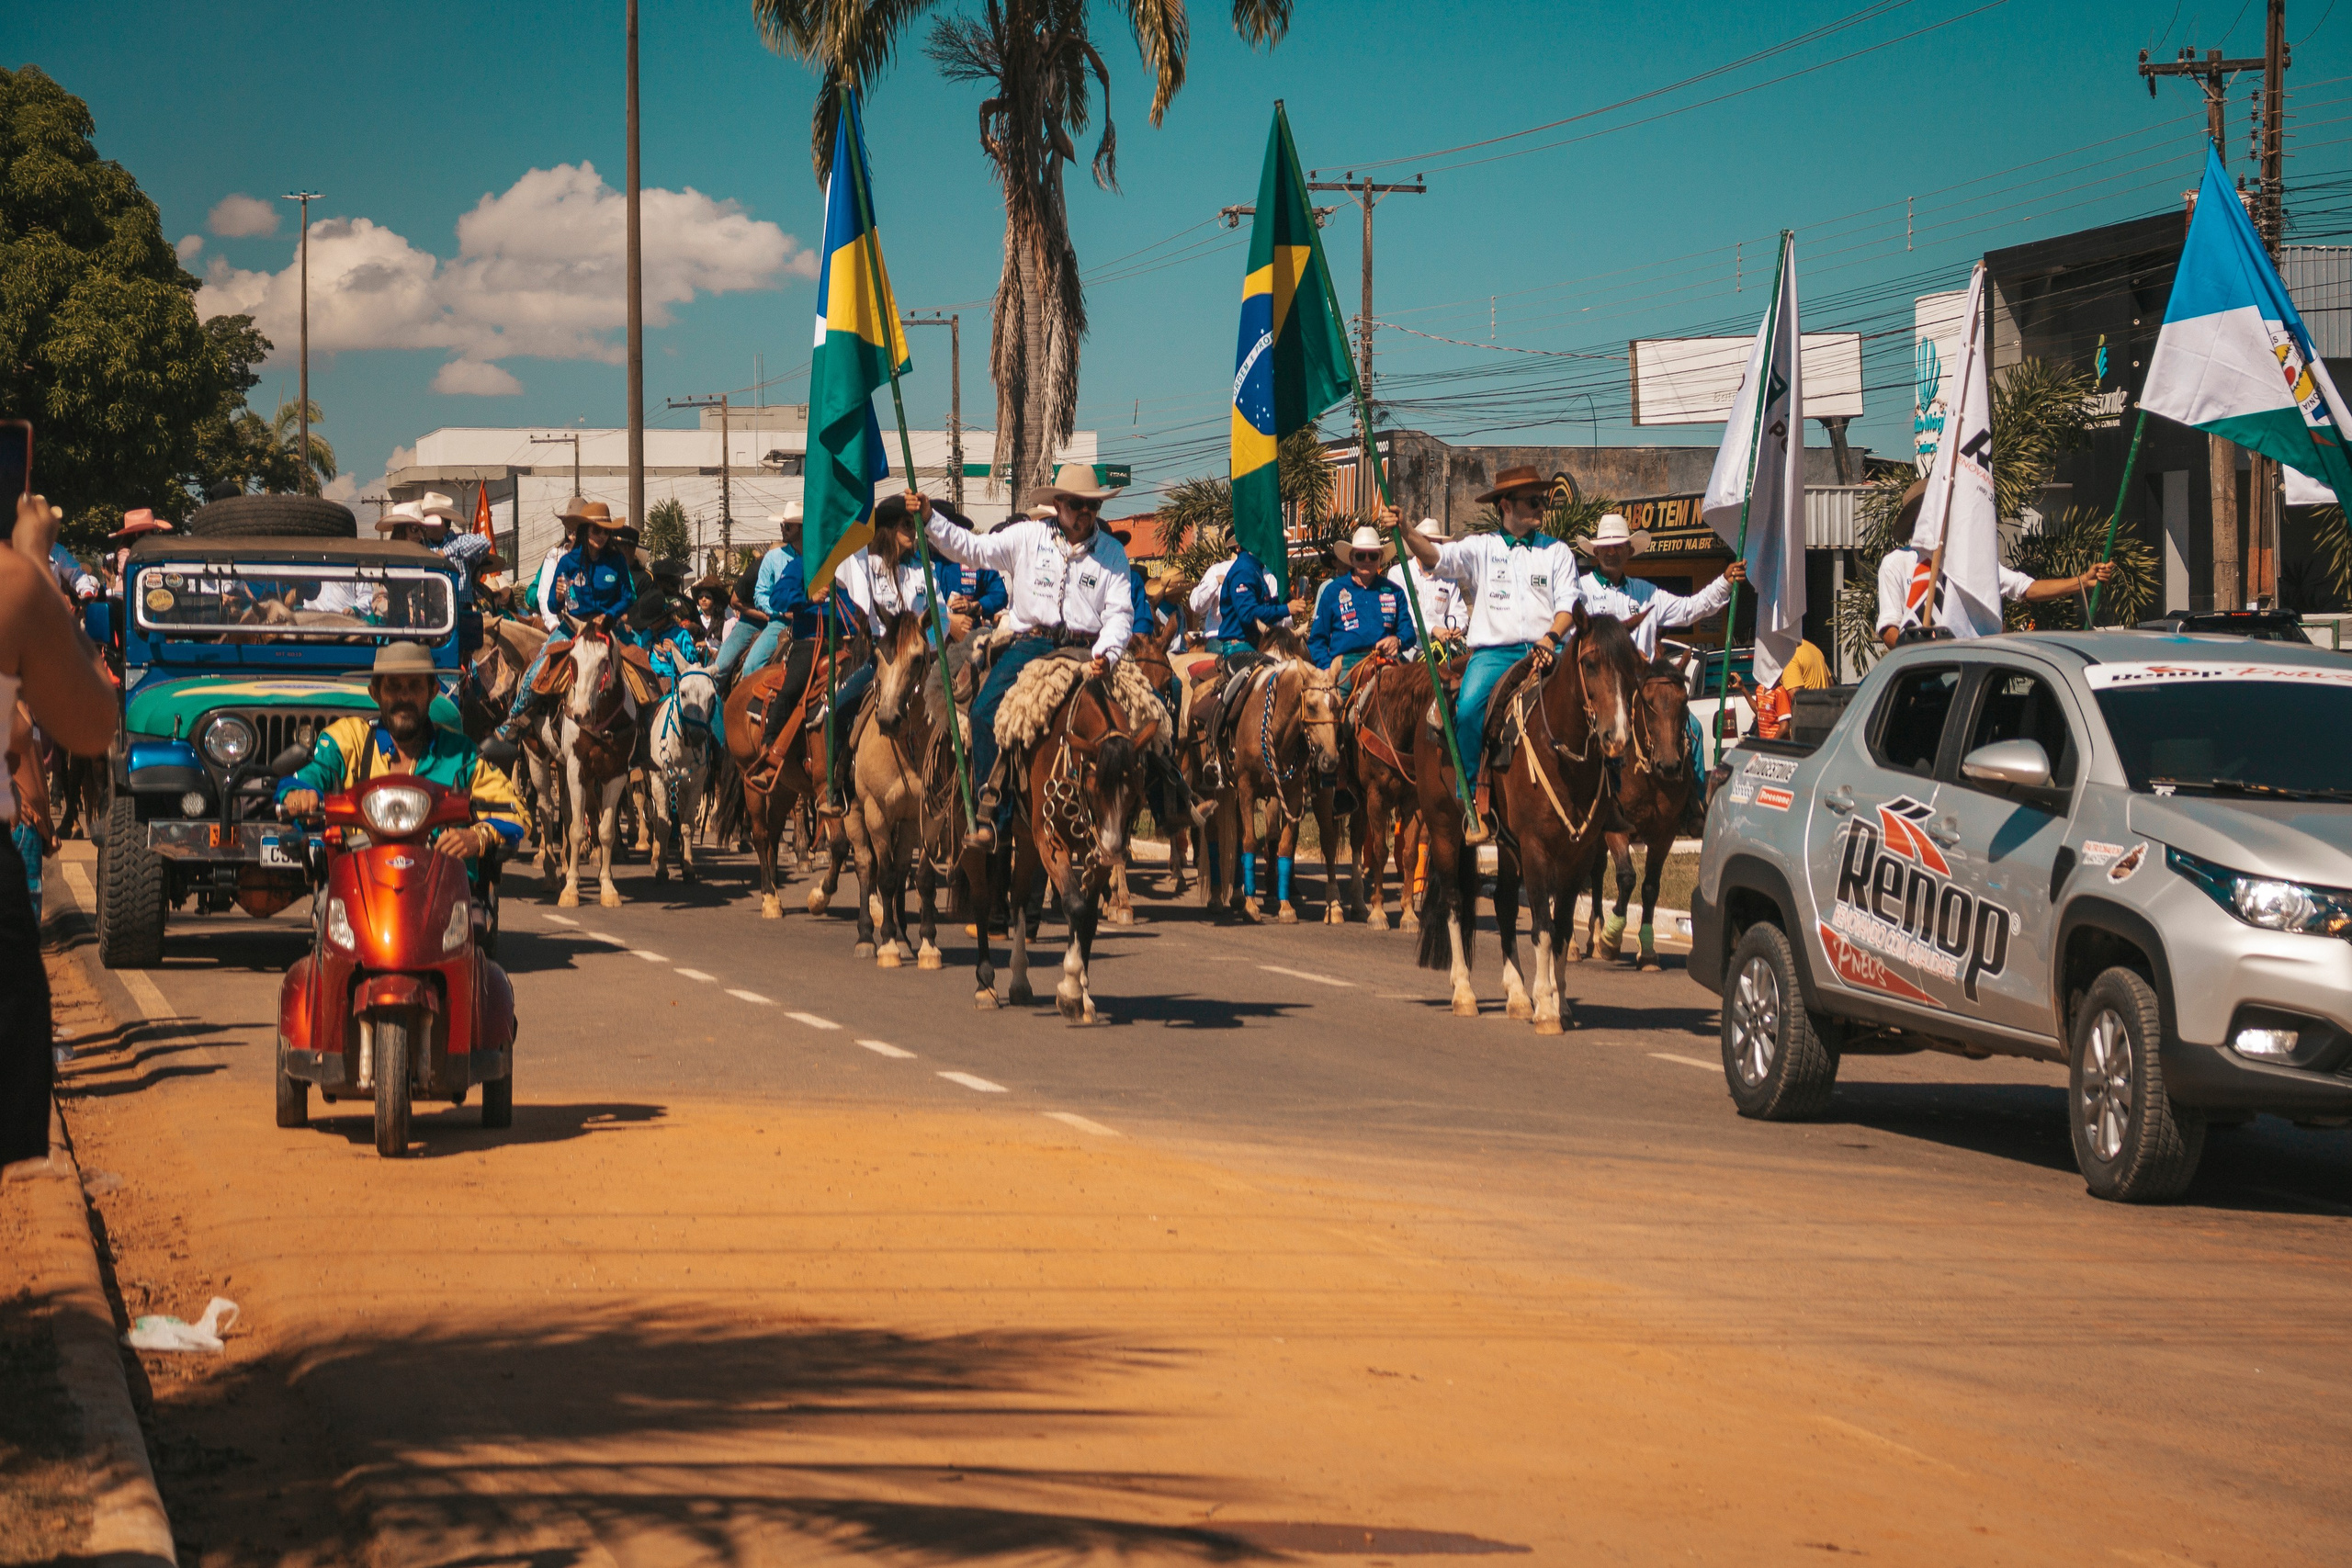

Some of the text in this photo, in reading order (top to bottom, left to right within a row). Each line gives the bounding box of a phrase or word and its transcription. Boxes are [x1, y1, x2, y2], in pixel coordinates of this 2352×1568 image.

[1233, 362, 1250, 397] ORDEM
[1657, 499, 1690, 528] TEM
[1657, 538, 1683, 552] FEITO
[1079, 572, 1098, 589] EC
[1531, 574, 1547, 587] EC
[1489, 592, 1511, 601] Cargill
[1832, 903, 1958, 985] RENOVANDO COM QUALIDADE
